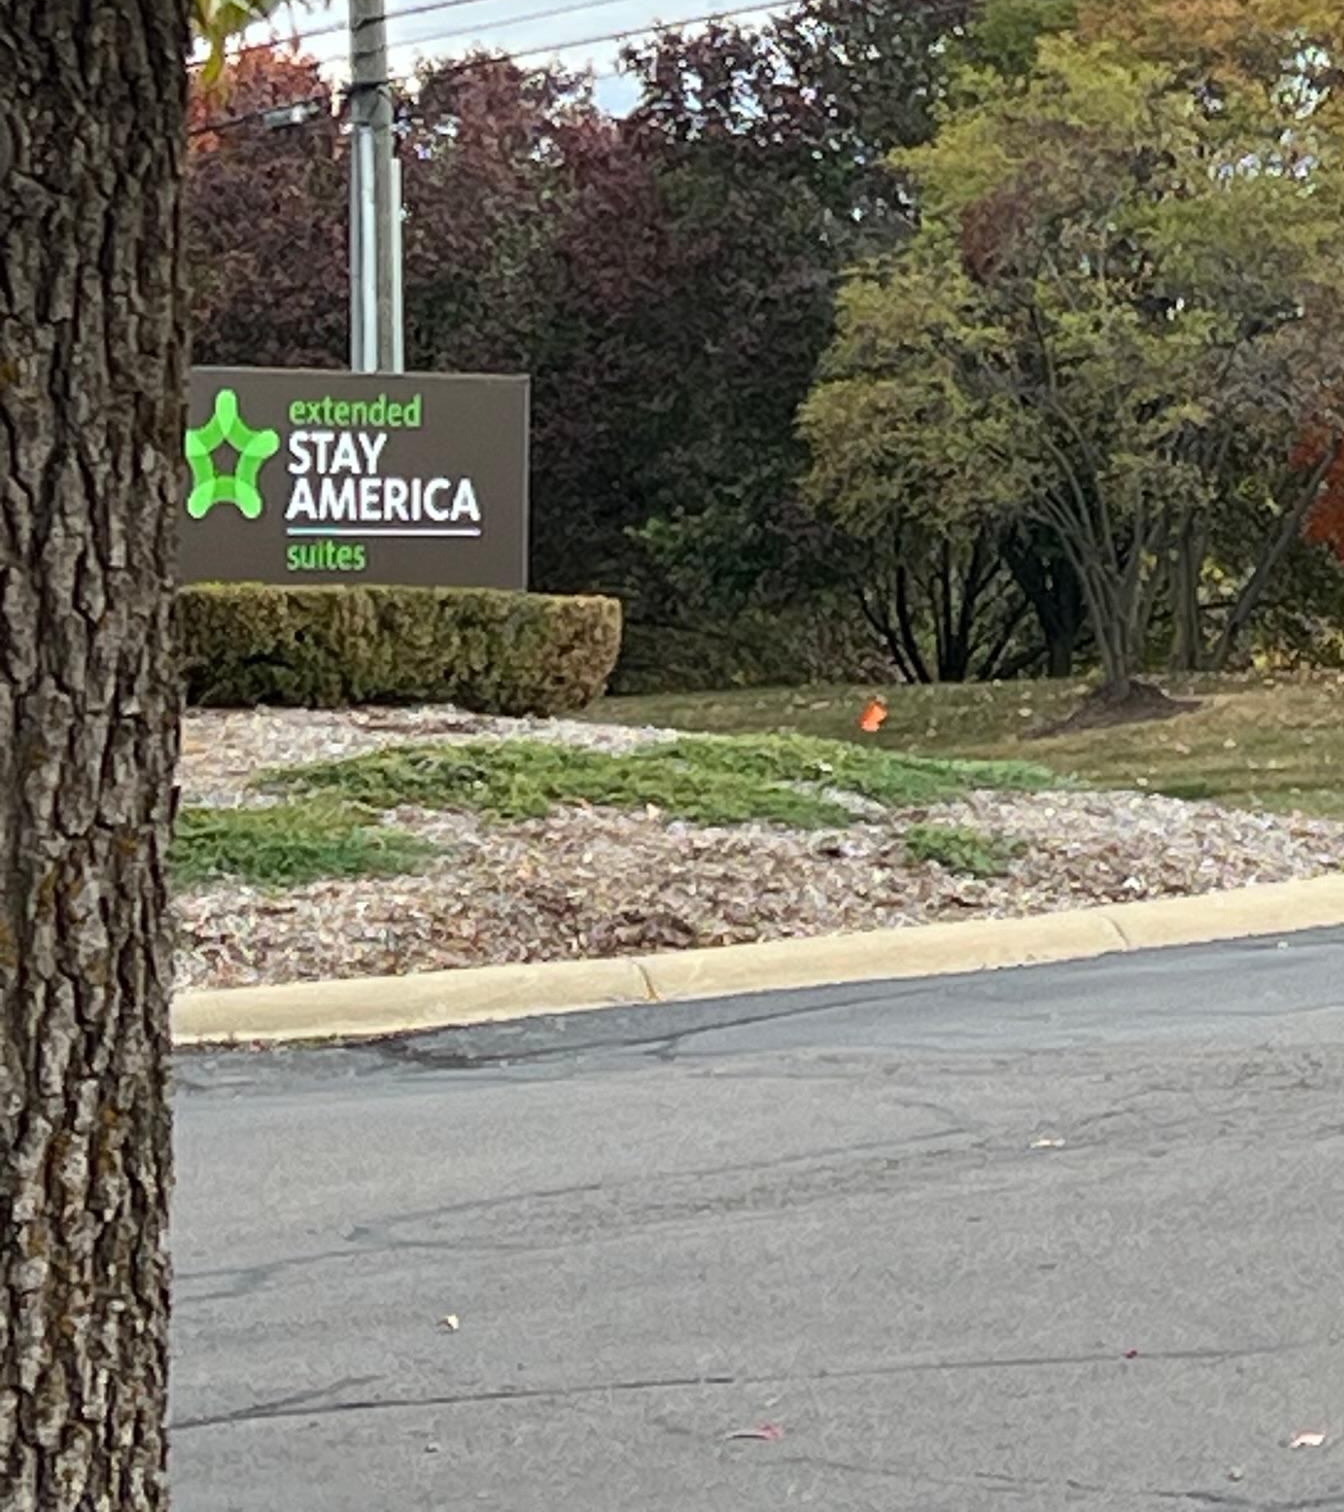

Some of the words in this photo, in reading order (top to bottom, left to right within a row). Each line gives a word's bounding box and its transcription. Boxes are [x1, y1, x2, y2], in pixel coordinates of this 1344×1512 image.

[289, 394, 422, 427] extended
[288, 431, 388, 475] STAY
[285, 478, 481, 521] AMERICA
[286, 539, 366, 570] suites
